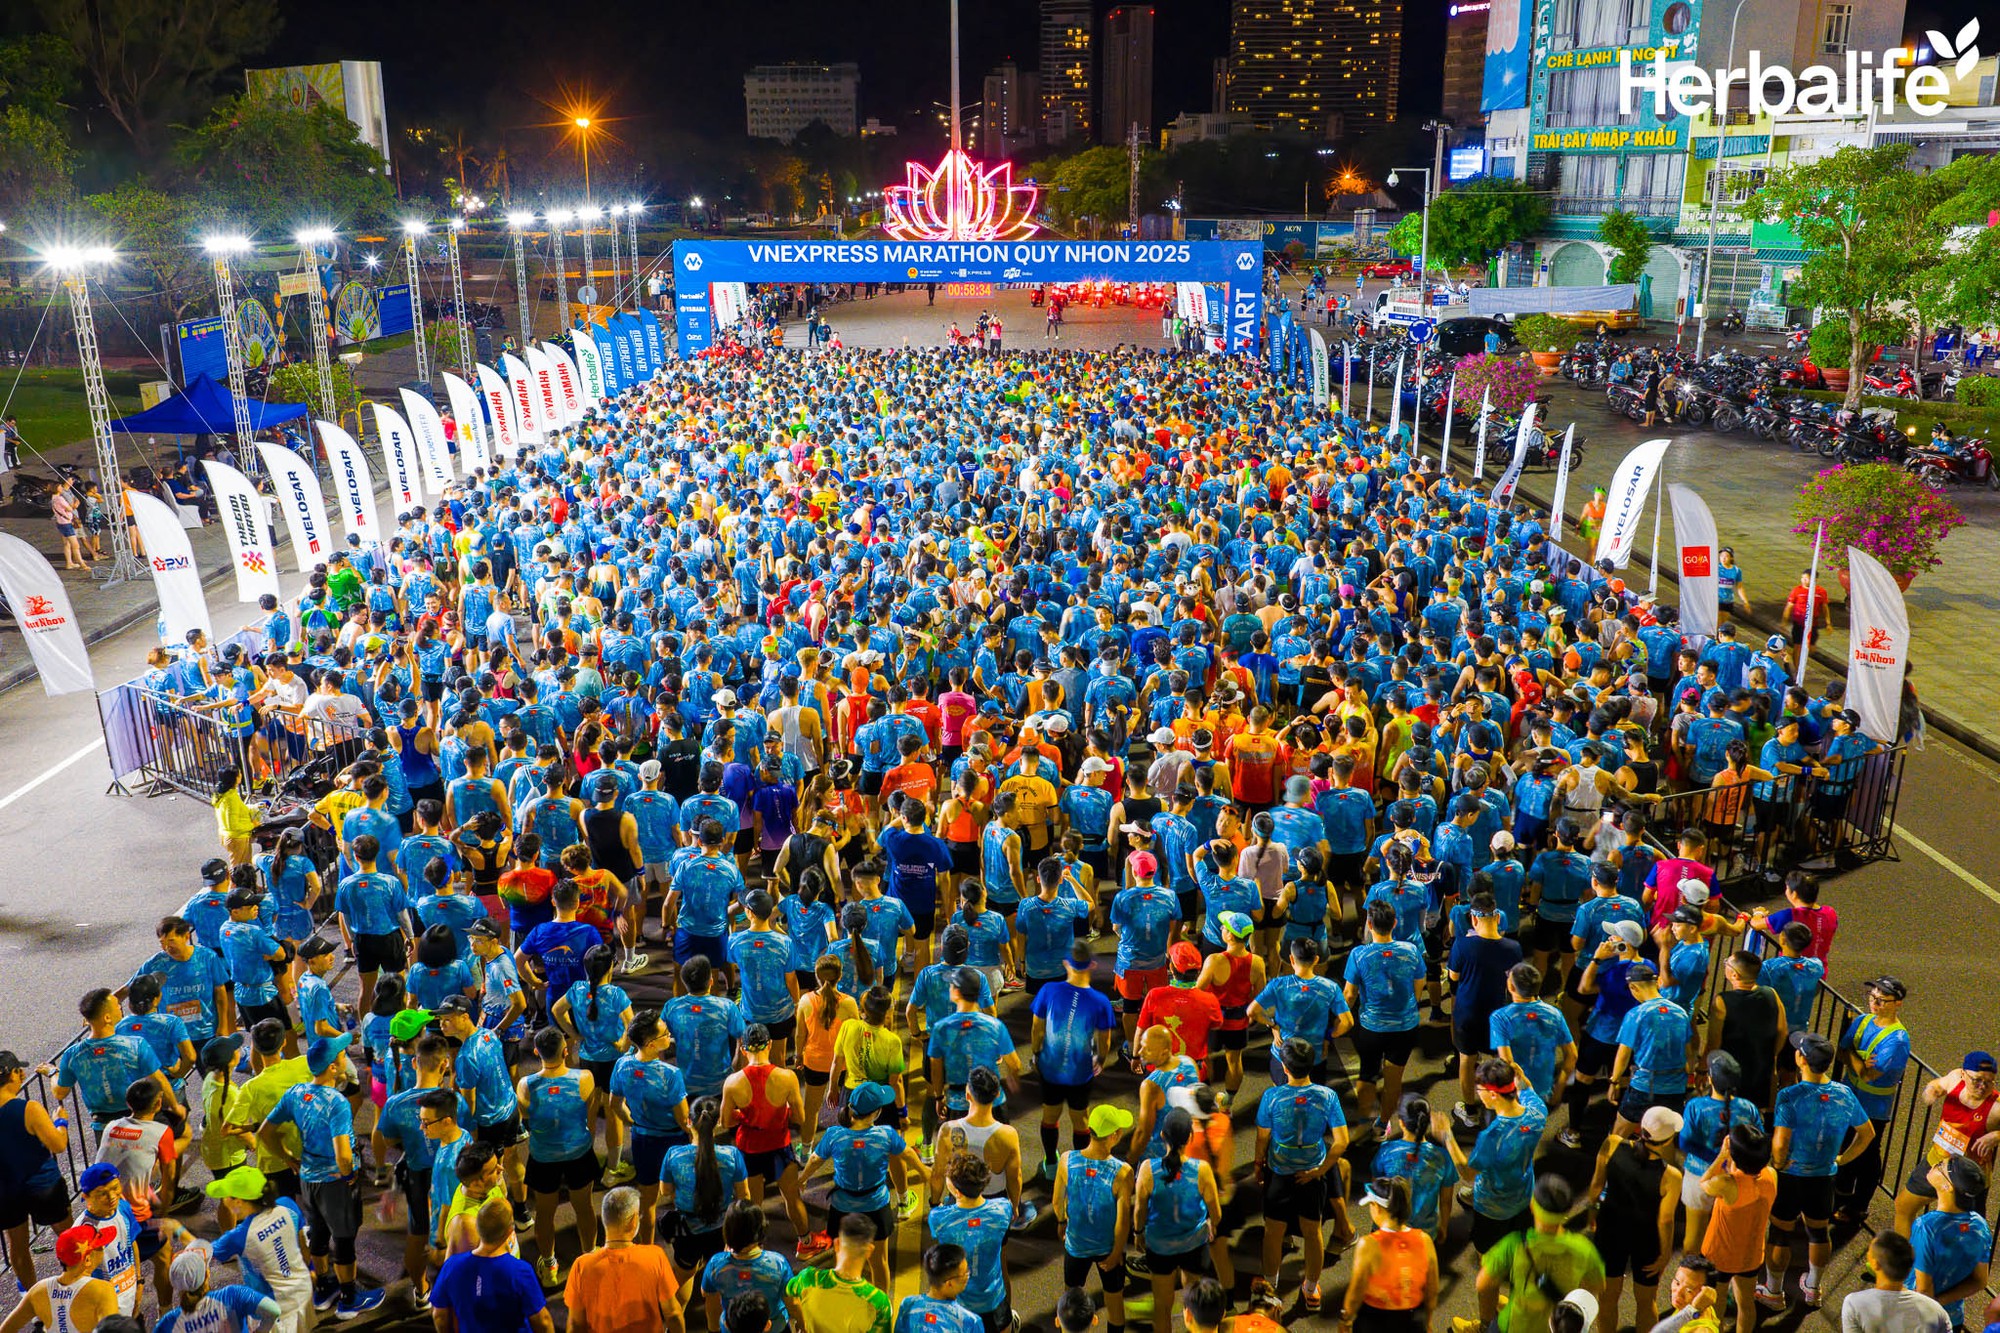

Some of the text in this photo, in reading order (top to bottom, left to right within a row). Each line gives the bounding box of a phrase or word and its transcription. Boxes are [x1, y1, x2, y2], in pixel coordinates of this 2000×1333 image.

[1547, 51, 1573, 68] CHÈ
[1576, 51, 1612, 69] LẠNH
[1534, 124, 1677, 150] TRÁI CÂY NHẬP KHẨU
[747, 243, 1191, 264] VNEXPRESS MARATHON QUY NHON 2025
[947, 283, 991, 297] 00:58:34
[557, 362, 577, 400] YAMAHA
[587, 352, 599, 398] Herbalife
[516, 379, 532, 420] YAMAHA
[538, 370, 555, 409] YAMAHA
[489, 391, 508, 434] YAMAHA
[165, 556, 189, 568] PVI
[257, 1216, 287, 1242] BHXH
[272, 1236, 292, 1278] RUNNERS
[52, 1289, 73, 1300] BHXH
[184, 1309, 220, 1333] BHXH
